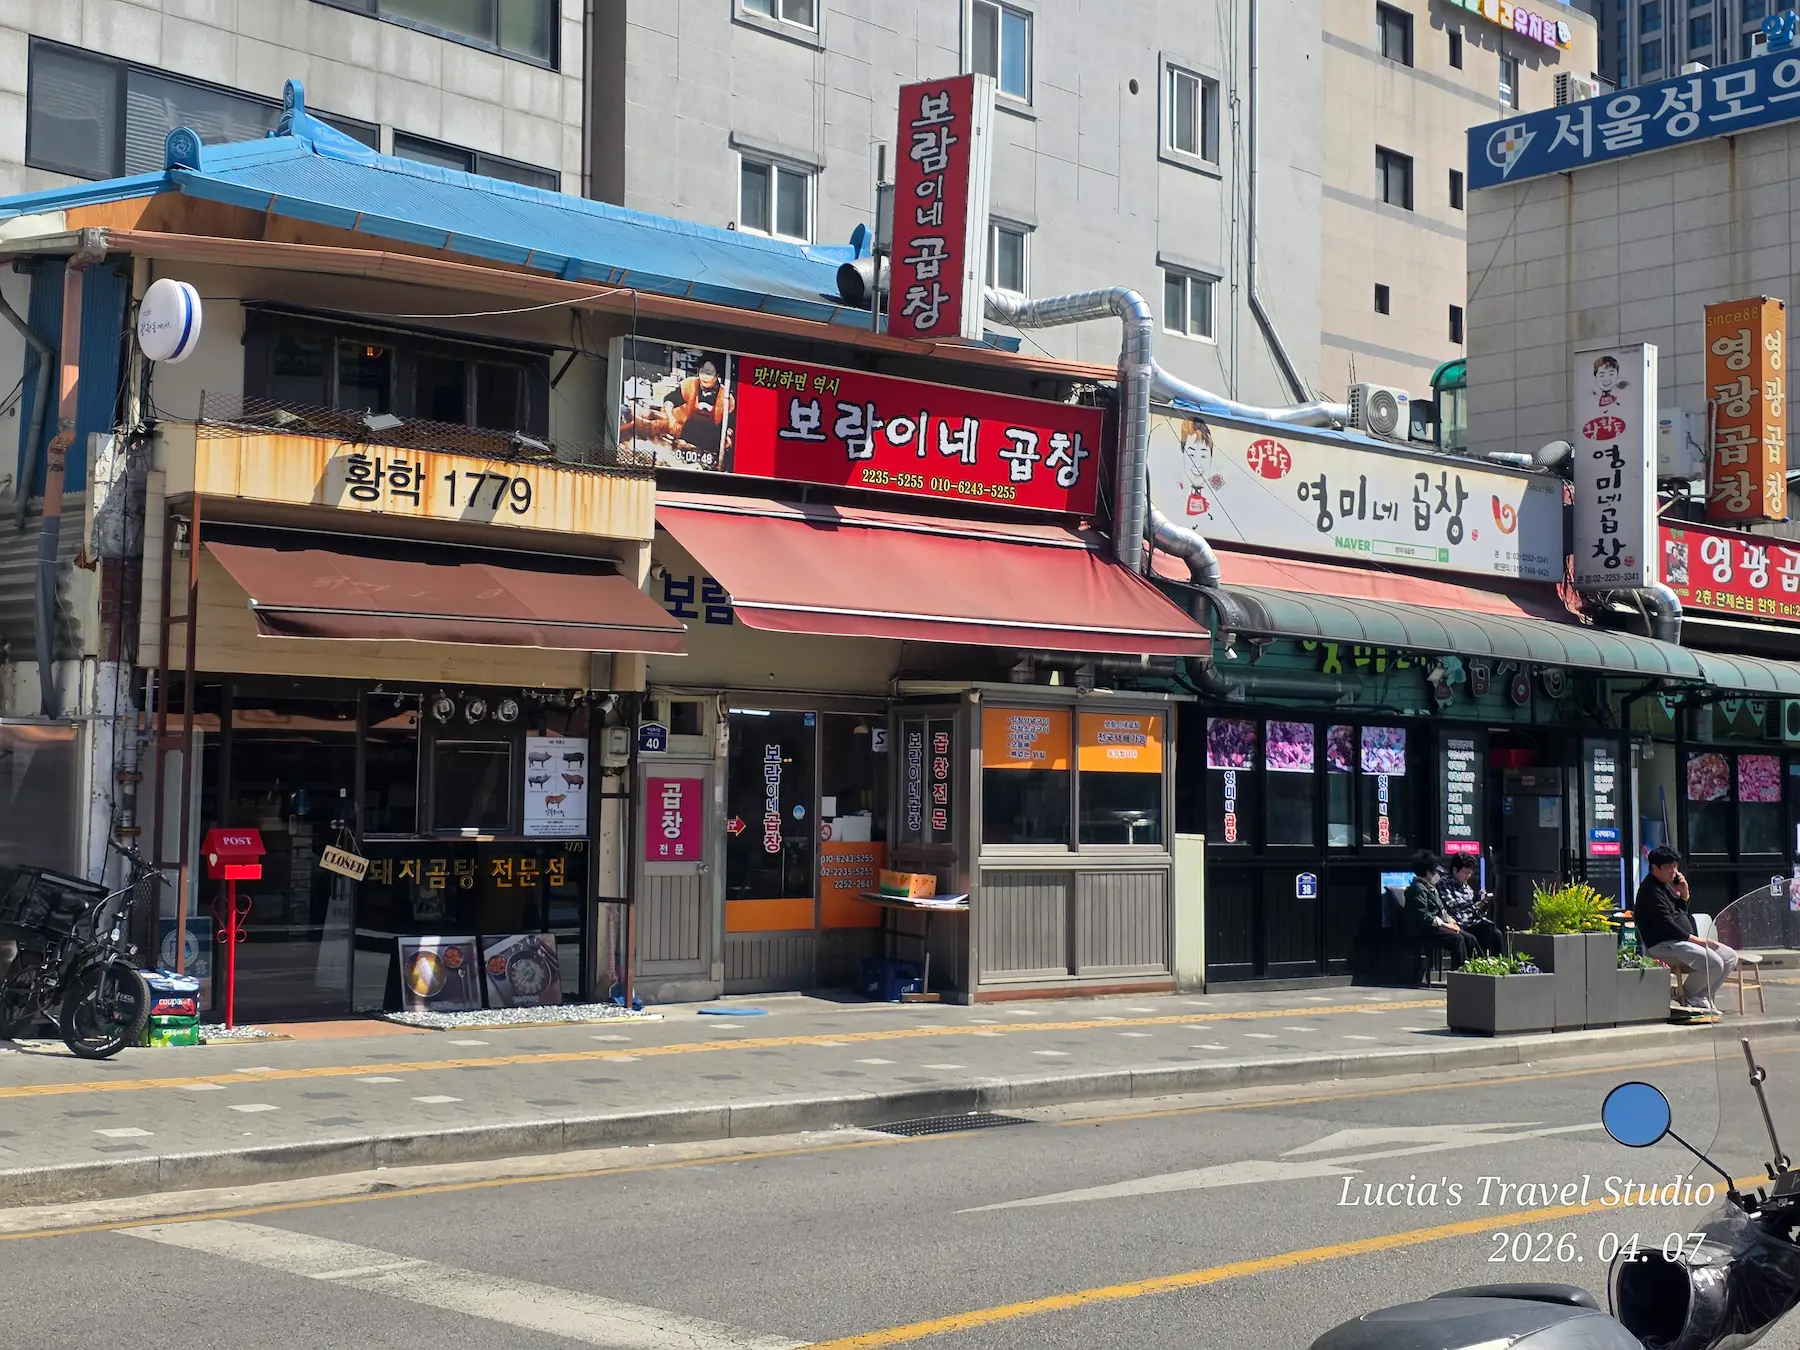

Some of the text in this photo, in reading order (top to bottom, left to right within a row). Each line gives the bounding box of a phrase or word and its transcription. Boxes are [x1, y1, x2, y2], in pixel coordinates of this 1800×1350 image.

[902, 91, 957, 330] 보람이네 곱창
[1707, 307, 1759, 327] since88
[813, 375, 840, 396] 역시
[1709, 328, 1760, 513] 영광곱창
[1763, 329, 1785, 513] 영광곱창
[779, 397, 1088, 488] 보람이네 곱창
[1247, 440, 1292, 478] 황학동
[345, 453, 532, 514] 황학 1779
[861, 468, 1017, 499] 2235-5255 010-6243-5255
[1297, 471, 1469, 545] 영미네 곱창
[1335, 537, 1371, 551] NAVER
[1695, 589, 1755, 611] 2층.단체손님
[1758, 597, 1777, 615] 환영
[646, 737, 660, 750] 40
[661, 783, 683, 839] 곱창
[222, 836, 252, 846] POST
[323, 850, 366, 875] CLOSED
[820, 854, 874, 864] 010-6243-5255
[820, 867, 874, 877] 02-2235-5255
[369, 857, 566, 890] 돼지곰탕 전문점
[1301, 884, 1312, 895] 38
